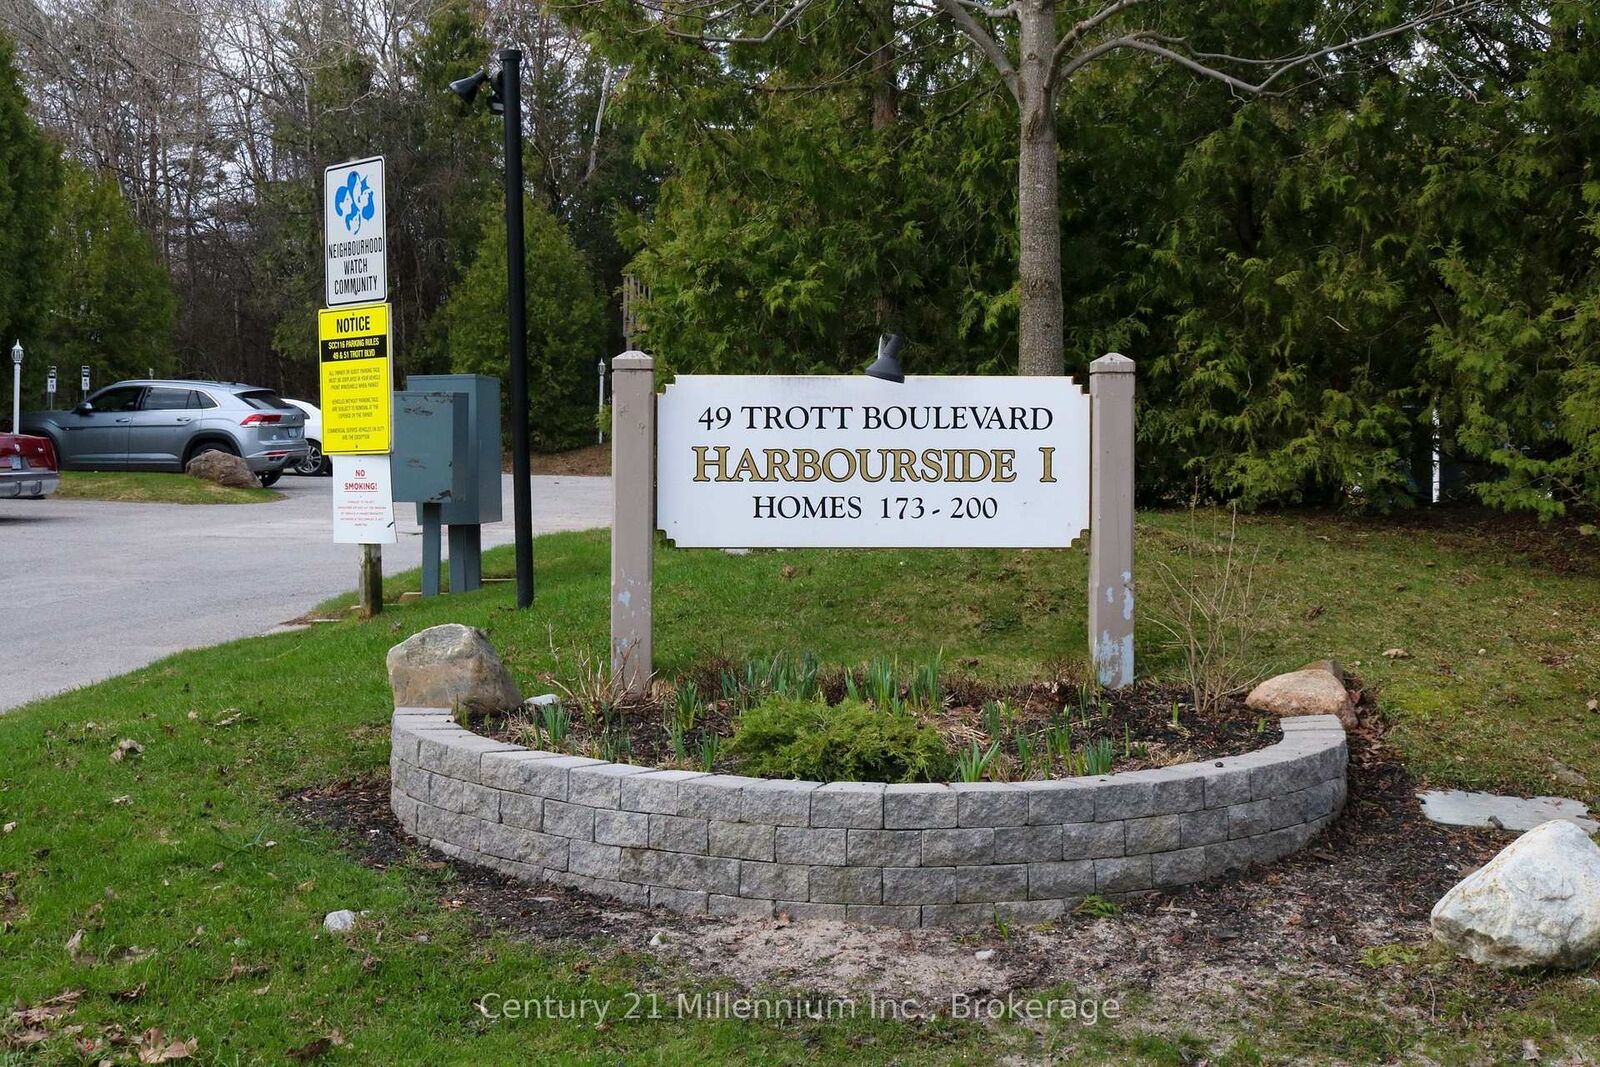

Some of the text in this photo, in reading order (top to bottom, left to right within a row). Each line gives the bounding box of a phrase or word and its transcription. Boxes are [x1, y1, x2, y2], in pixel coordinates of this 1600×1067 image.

[328, 237, 383, 259] NEIGHBOURHOOD
[343, 258, 368, 275] WATCH
[334, 275, 378, 295] COMMUNITY
[336, 316, 371, 333] NOTICE
[345, 339, 365, 348] PARKING
[365, 337, 380, 347] RULES
[349, 349, 364, 359] TROTT
[364, 348, 376, 357] BLVD
[698, 406, 1054, 431] 49 TROTT BOULEVARD
[355, 469, 366, 477] NO
[691, 446, 1058, 483] HARBOURSIDE I
[344, 482, 378, 490] SMOKING!
[752, 496, 863, 519] HOMES
[880, 497, 925, 520] 173
[950, 497, 998, 519] 200
